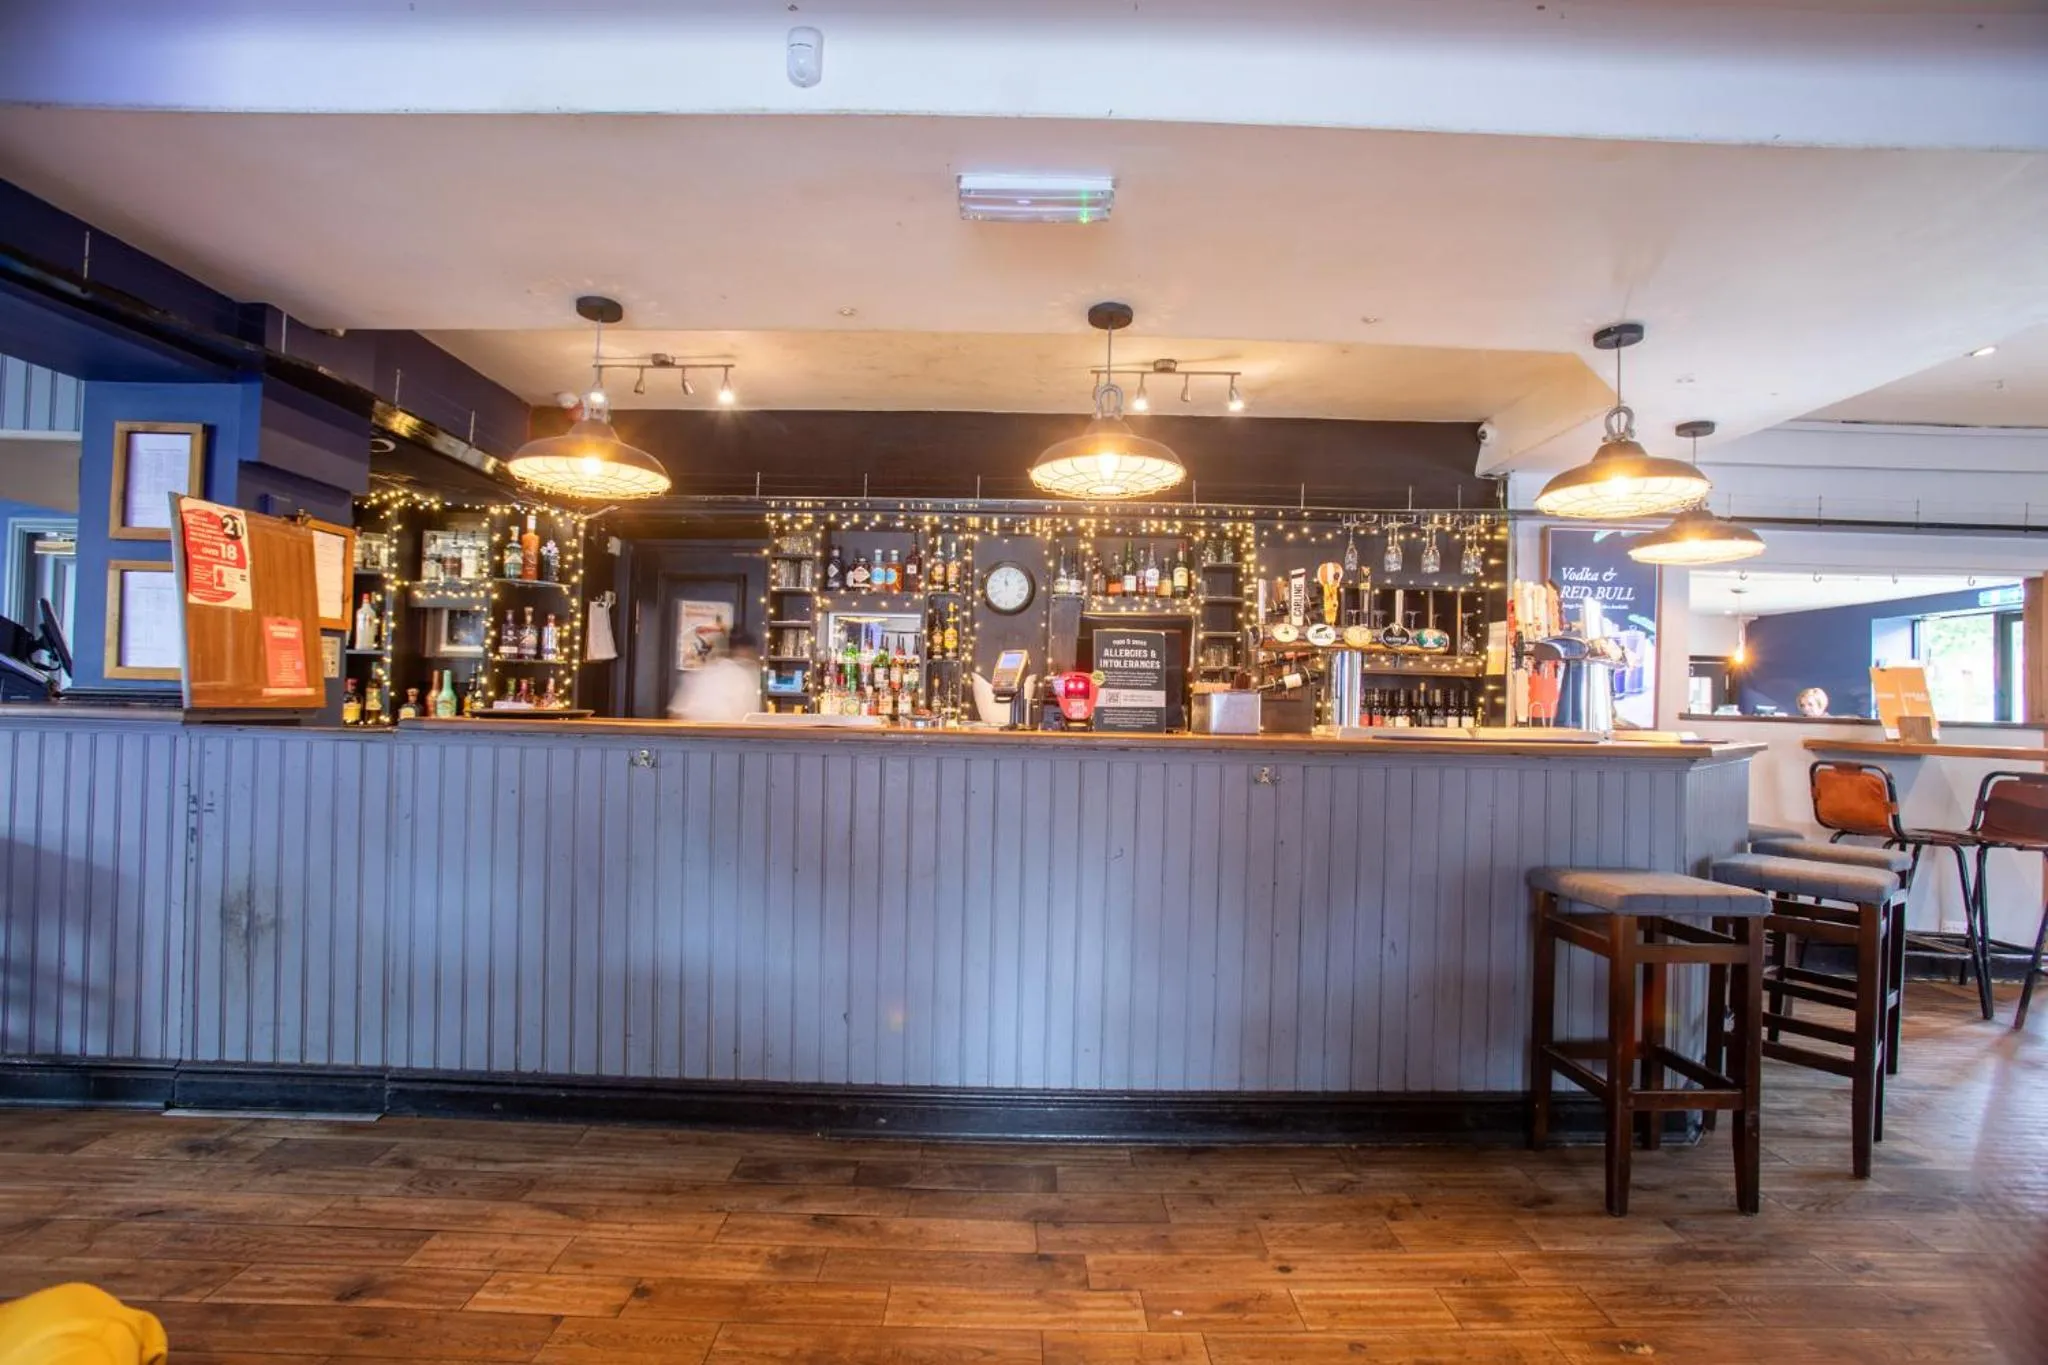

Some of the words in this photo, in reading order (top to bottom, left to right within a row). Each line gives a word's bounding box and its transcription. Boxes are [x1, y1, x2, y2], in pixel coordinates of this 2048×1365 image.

[222, 516, 242, 536] 21
[220, 543, 238, 561] 18
[1561, 567, 1599, 581] Vodka
[1602, 567, 1618, 582] &
[1293, 583, 1303, 617] CARLING
[1560, 585, 1592, 599] RED
[1595, 586, 1635, 600] BULL
[1103, 648, 1148, 658] ALLERGIES
[1100, 659, 1160, 669] INTOLERANCES
